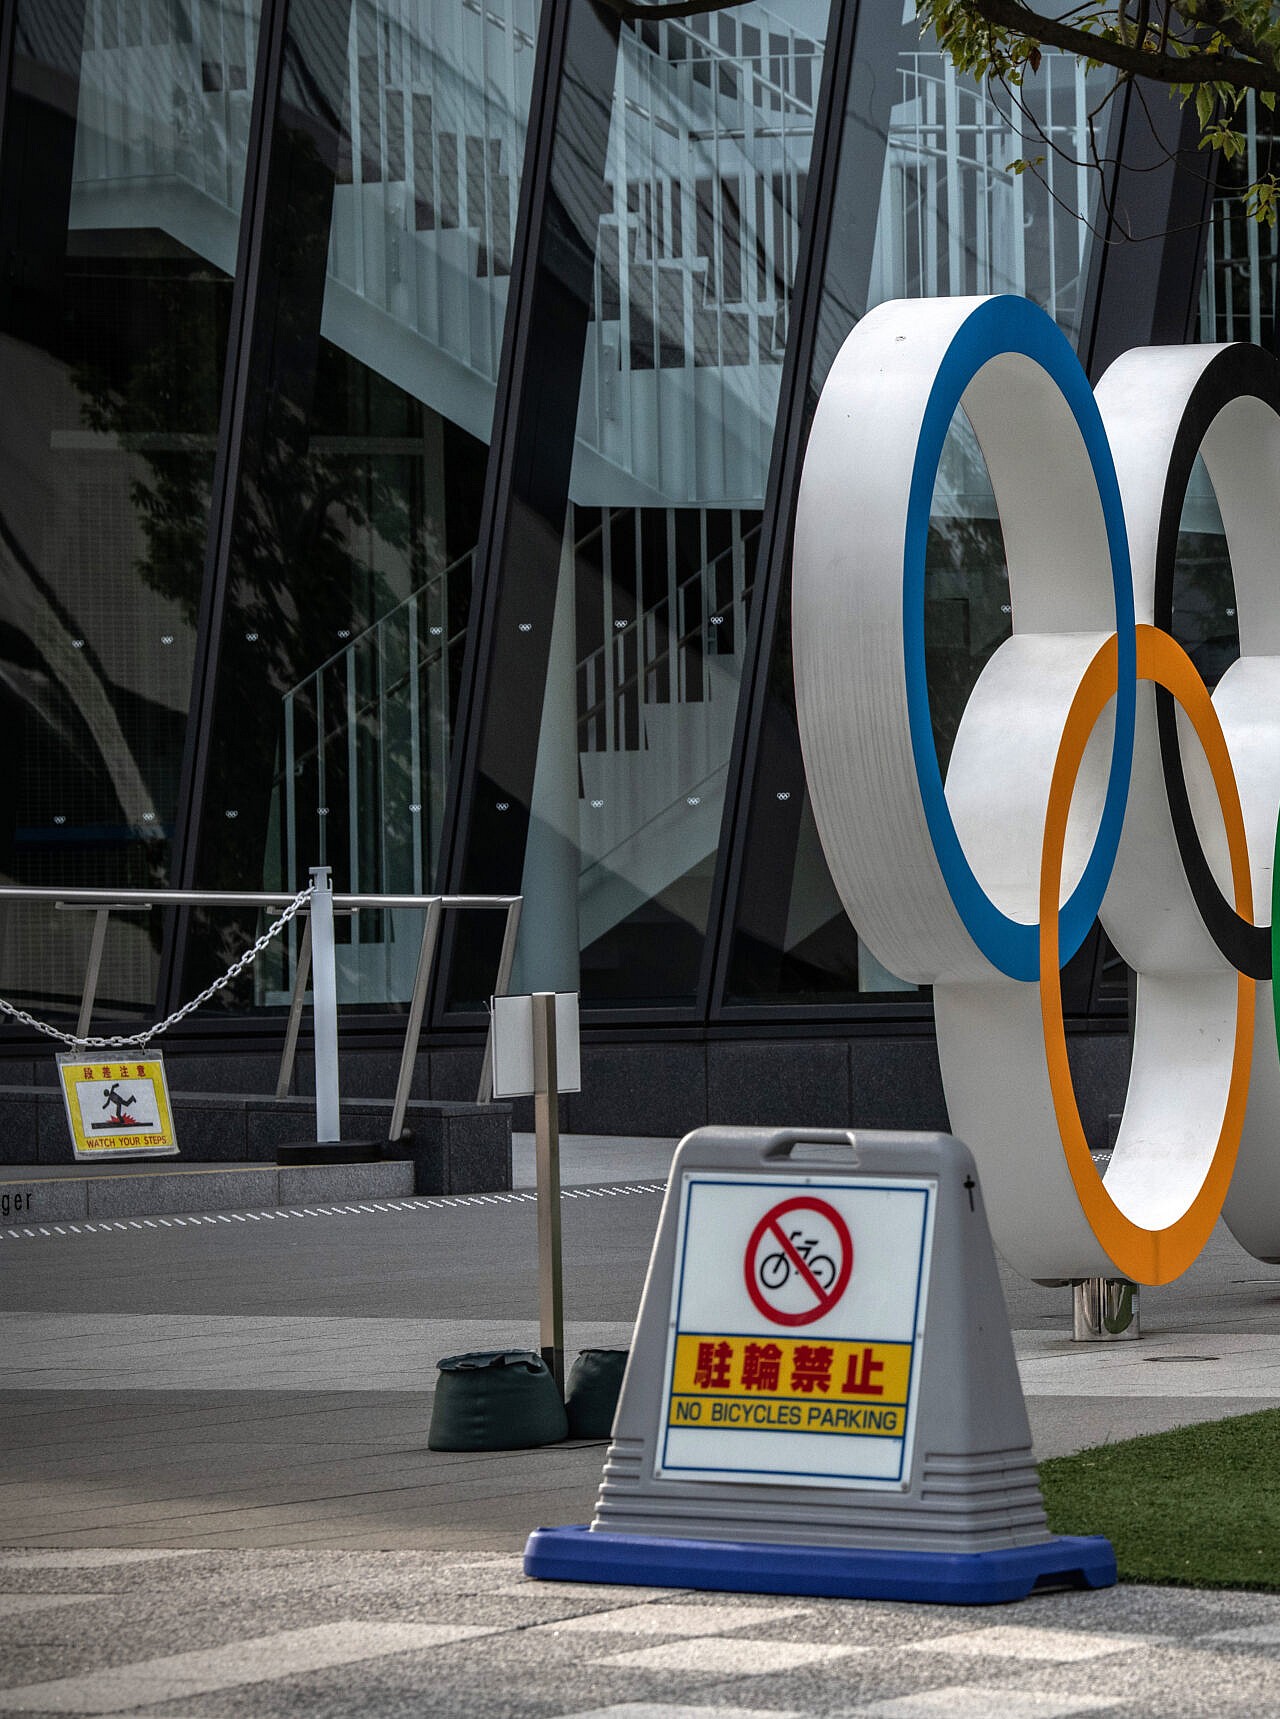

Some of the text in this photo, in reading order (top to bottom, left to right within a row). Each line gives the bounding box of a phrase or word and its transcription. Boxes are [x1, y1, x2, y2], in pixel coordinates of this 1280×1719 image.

[83, 1065, 146, 1079] 段差注意
[86, 1136, 167, 1148] WATCH YOUR STEPS
[694, 1341, 884, 1395] 駐輪禁止
[676, 1402, 897, 1431] NO BICYCLES PARKING
